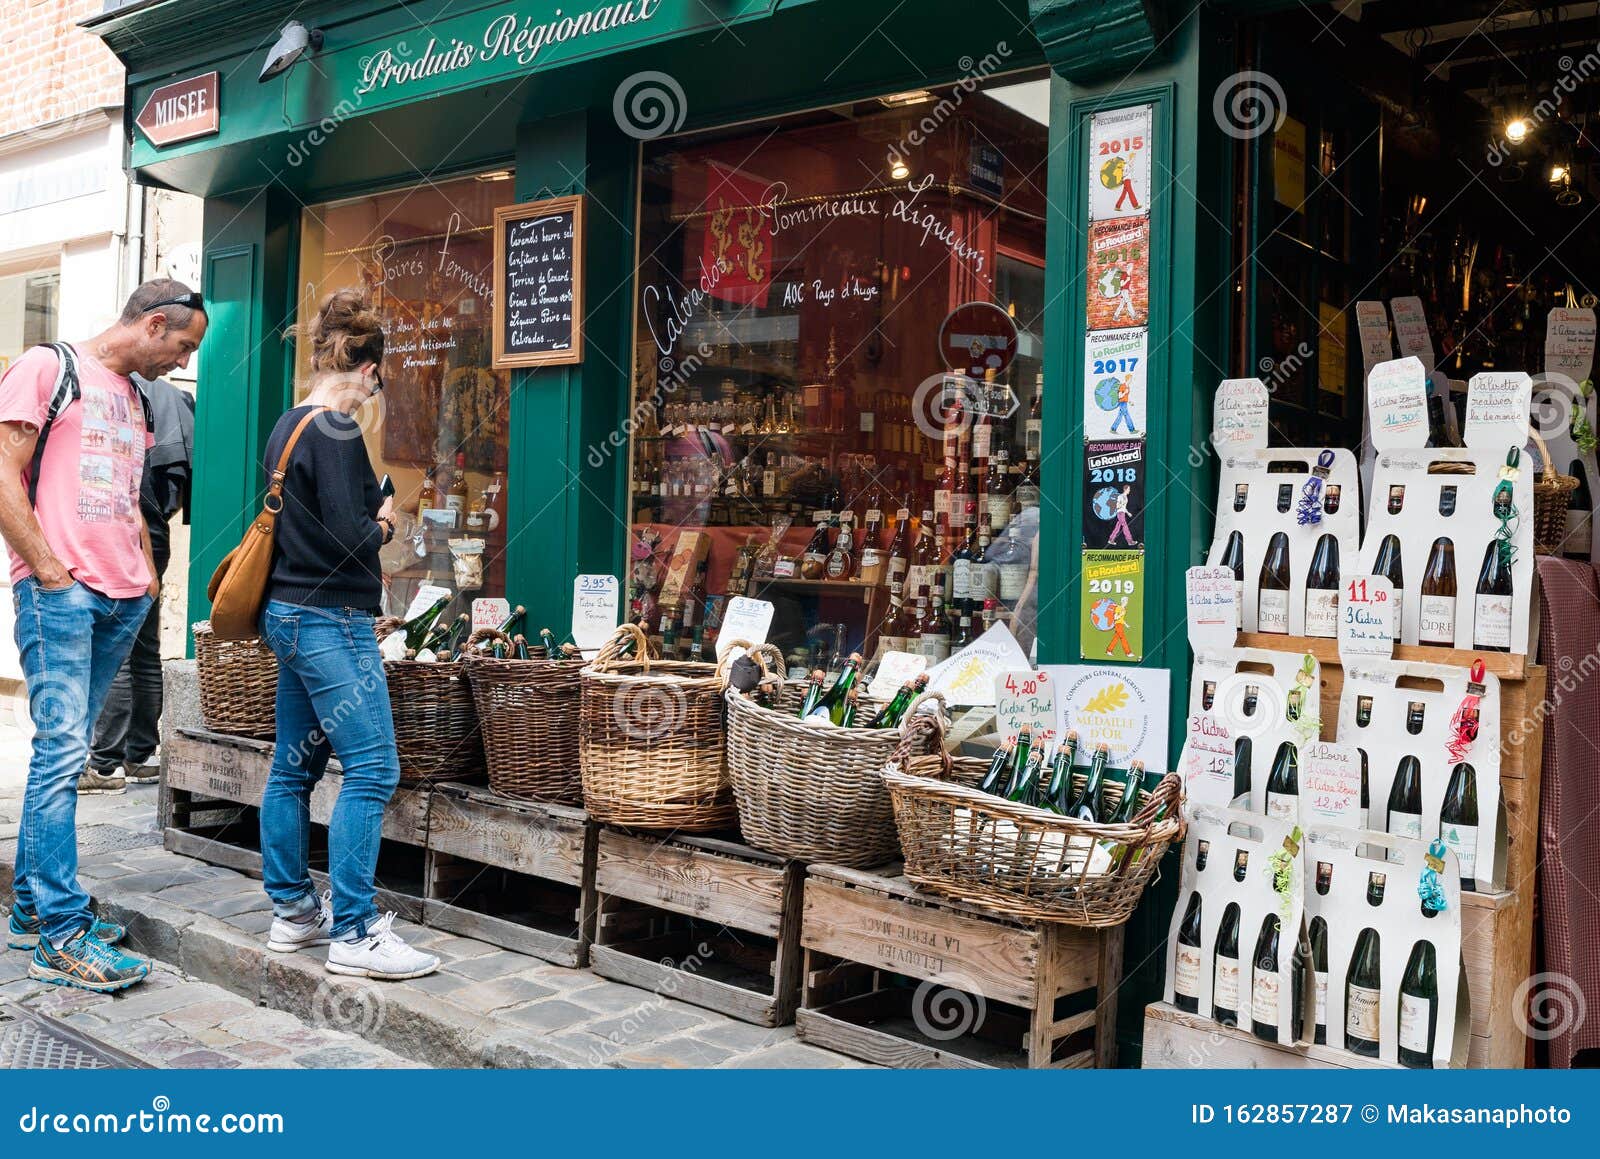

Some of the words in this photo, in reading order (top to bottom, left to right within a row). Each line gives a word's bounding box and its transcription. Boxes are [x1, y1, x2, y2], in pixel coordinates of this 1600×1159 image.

[359, 39, 475, 94] Produits
[481, 0, 663, 65] Régionaux
[155, 88, 207, 129] MUSEE
[1099, 136, 1144, 155] 2015
[1095, 240, 1105, 250] Le
[1106, 229, 1141, 247] Routard
[542, 252, 549, 262] de
[1097, 248, 1141, 265] 2016
[509, 272, 535, 288] Terrine
[538, 272, 546, 283] de
[530, 293, 537, 305] de
[783, 282, 804, 308] AOC
[813, 283, 835, 307] Pays
[842, 275, 878, 301] d'Auge
[509, 310, 536, 330] Liqueur
[541, 308, 560, 324] Poire
[1132, 331, 1144, 339] PAR
[420, 338, 457, 354] Artisanale
[1104, 341, 1141, 356] Routard
[1093, 358, 1138, 374] 2017
[1468, 410, 1480, 421] la
[1483, 412, 1521, 424] demande
[1130, 442, 1142, 450] PAR
[1090, 459, 1101, 468] Le
[1101, 450, 1139, 466] Routard
[1090, 468, 1136, 483] 2018
[1088, 569, 1098, 578] Le
[1100, 562, 1137, 576] Routard
[1089, 579, 1134, 594] 2019
[1348, 578, 1387, 605] 11,50
[1260, 611, 1288, 623] CIDRE
[1345, 606, 1353, 623] 3
[1354, 608, 1383, 625] Cidres
[1420, 618, 1453, 632] CIDRE
[1350, 628, 1366, 639] Brut
[1066, 673, 1093, 701] CONCOURS
[1122, 675, 1147, 703] AGRICOLE
[1000, 698, 1025, 716] Cidre
[1027, 697, 1052, 716] Brut
[1090, 727, 1122, 740] D'OR
[1191, 717, 1201, 732] 3
[1202, 717, 1230, 739] Cidres
[1314, 777, 1336, 792] Cidre
[897, 924, 937, 947] FERTE
[944, 936, 960, 953] LA
[877, 943, 943, 973] LELOUVIER
